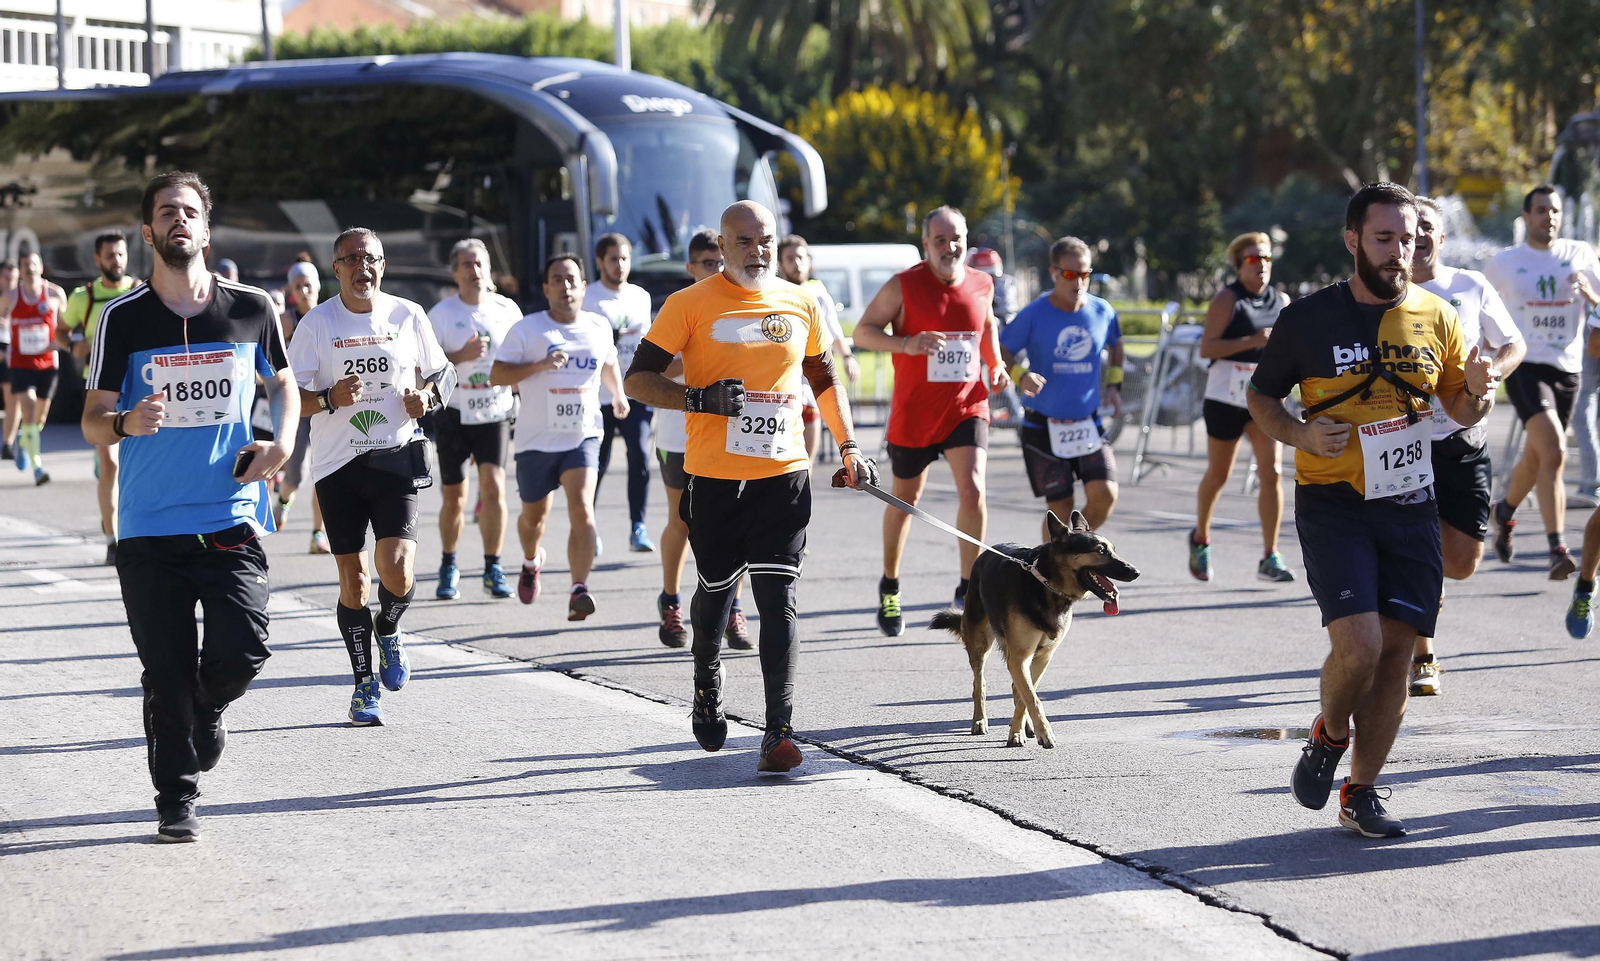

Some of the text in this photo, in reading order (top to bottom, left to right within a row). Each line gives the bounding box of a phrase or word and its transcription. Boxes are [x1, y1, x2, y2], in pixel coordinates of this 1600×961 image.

[621, 94, 694, 117] Diego
[1533, 315, 1566, 329] 9488
[154, 356, 170, 367] 41
[937, 350, 972, 364] 9879
[343, 356, 389, 376] 2568
[162, 378, 232, 402] 18800
[740, 415, 786, 435] 3294
[1361, 426, 1377, 437] 41
[350, 438, 387, 446] Fundación
[1059, 428, 1091, 443] 2227
[1379, 440, 1423, 471] 1258
